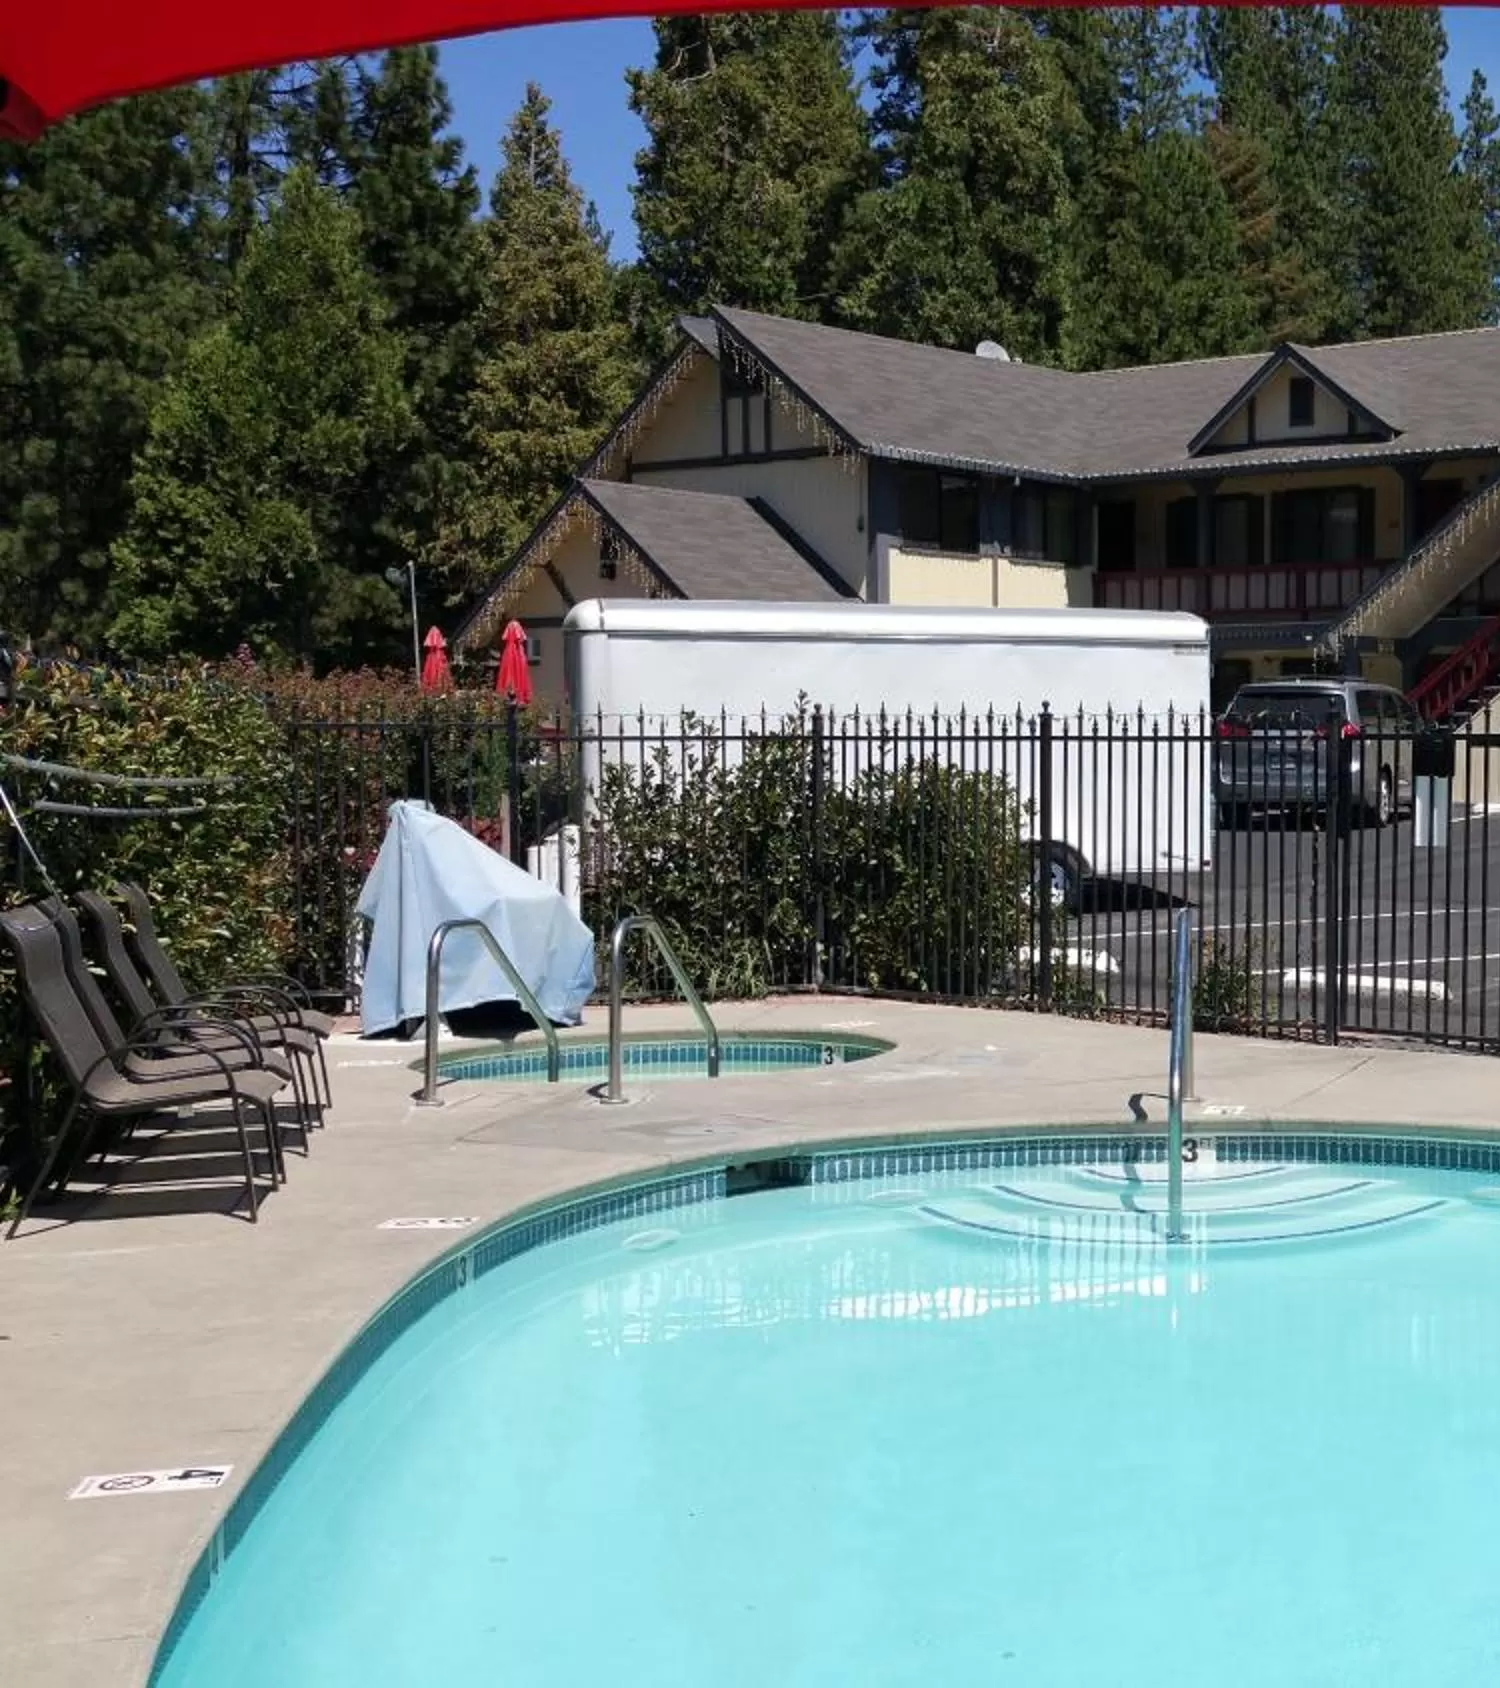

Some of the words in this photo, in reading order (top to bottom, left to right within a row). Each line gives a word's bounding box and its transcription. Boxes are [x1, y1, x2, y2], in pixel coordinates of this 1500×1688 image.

[823, 1045, 834, 1065] 3
[1181, 1138, 1198, 1163] 3
[459, 1255, 467, 1287] 3
